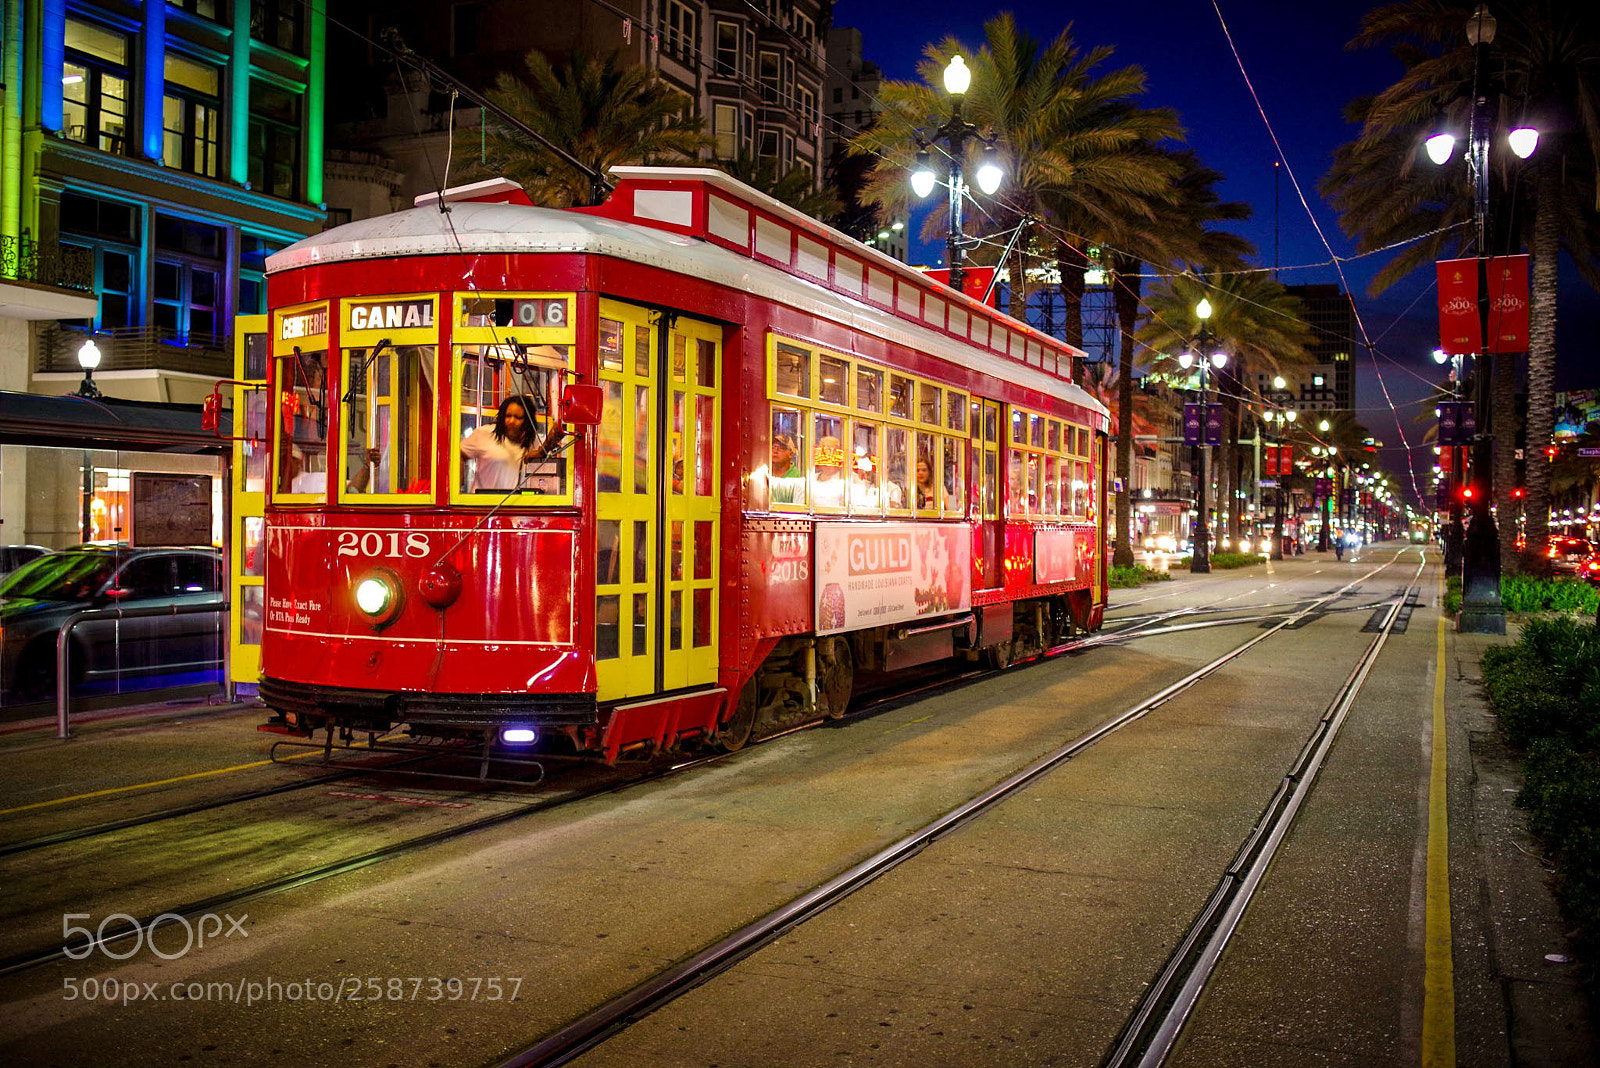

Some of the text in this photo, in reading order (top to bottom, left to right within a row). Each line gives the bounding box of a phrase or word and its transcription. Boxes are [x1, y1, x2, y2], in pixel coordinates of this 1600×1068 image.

[351, 303, 434, 330] CANAL
[519, 303, 564, 324] 06
[337, 532, 431, 558] 2018
[849, 536, 911, 572] GUILD
[771, 559, 809, 582] 2018
[309, 600, 321, 611] Fare
[295, 613, 311, 626] Ready
